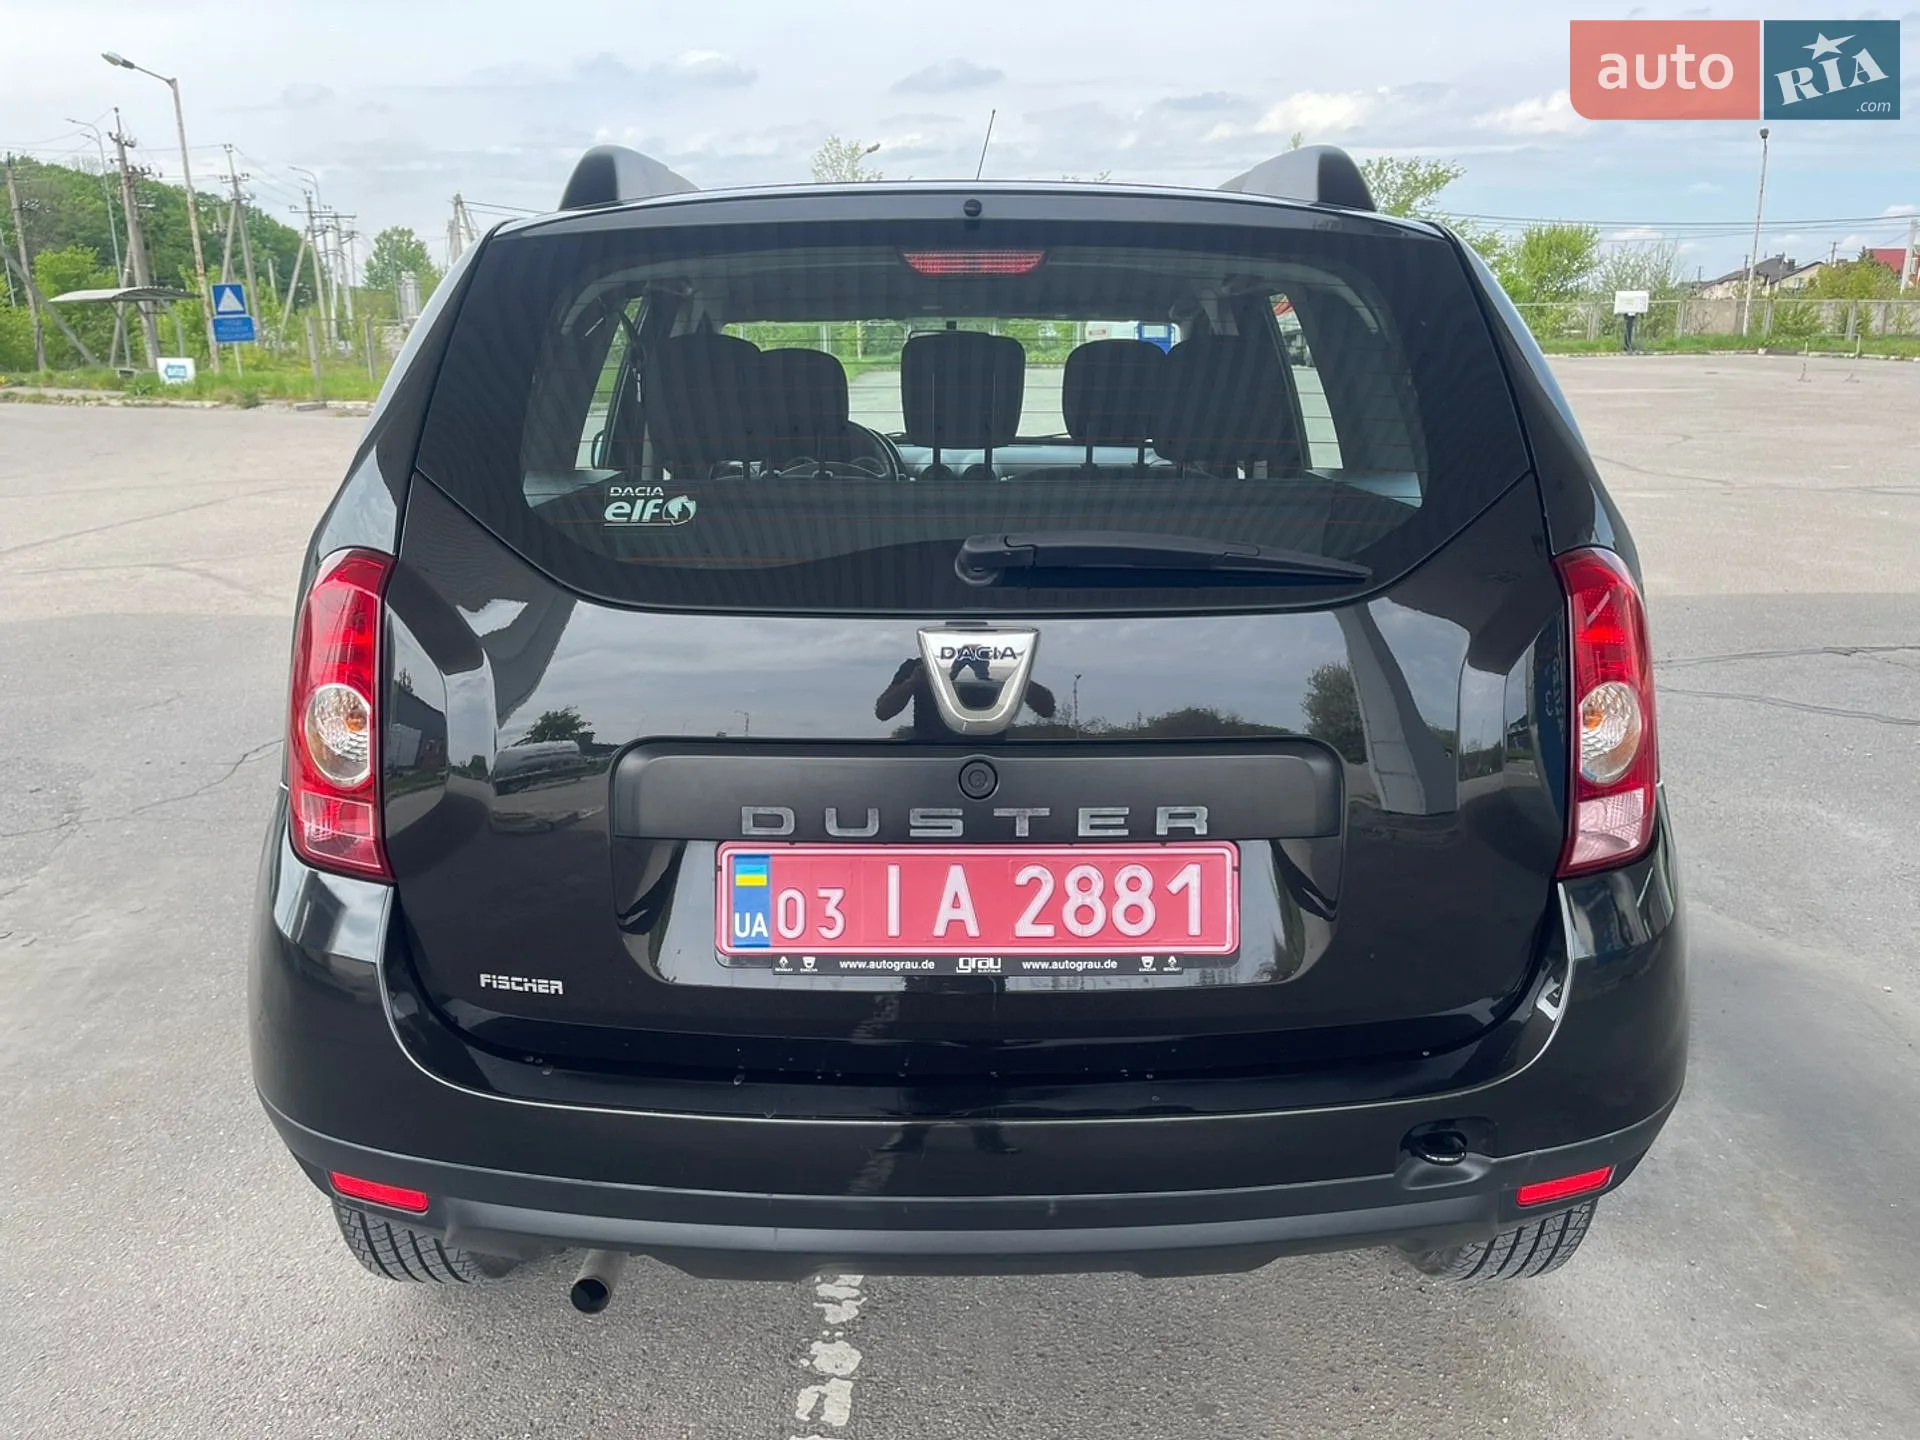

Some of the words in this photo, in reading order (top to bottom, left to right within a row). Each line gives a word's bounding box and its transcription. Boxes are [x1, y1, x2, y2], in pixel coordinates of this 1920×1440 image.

[610, 486, 664, 496] DACIA
[604, 498, 664, 522] elf
[940, 646, 1017, 660] DACIA
[741, 806, 1209, 838] DUSTER
[776, 887, 846, 939] 03
[887, 864, 980, 937] IA
[1013, 864, 1202, 937] 2881
[734, 912, 769, 938] UA
[839, 959, 935, 972] www.autograu.de
[956, 957, 1001, 973] grau
[1022, 959, 1118, 972] www.autograu.de
